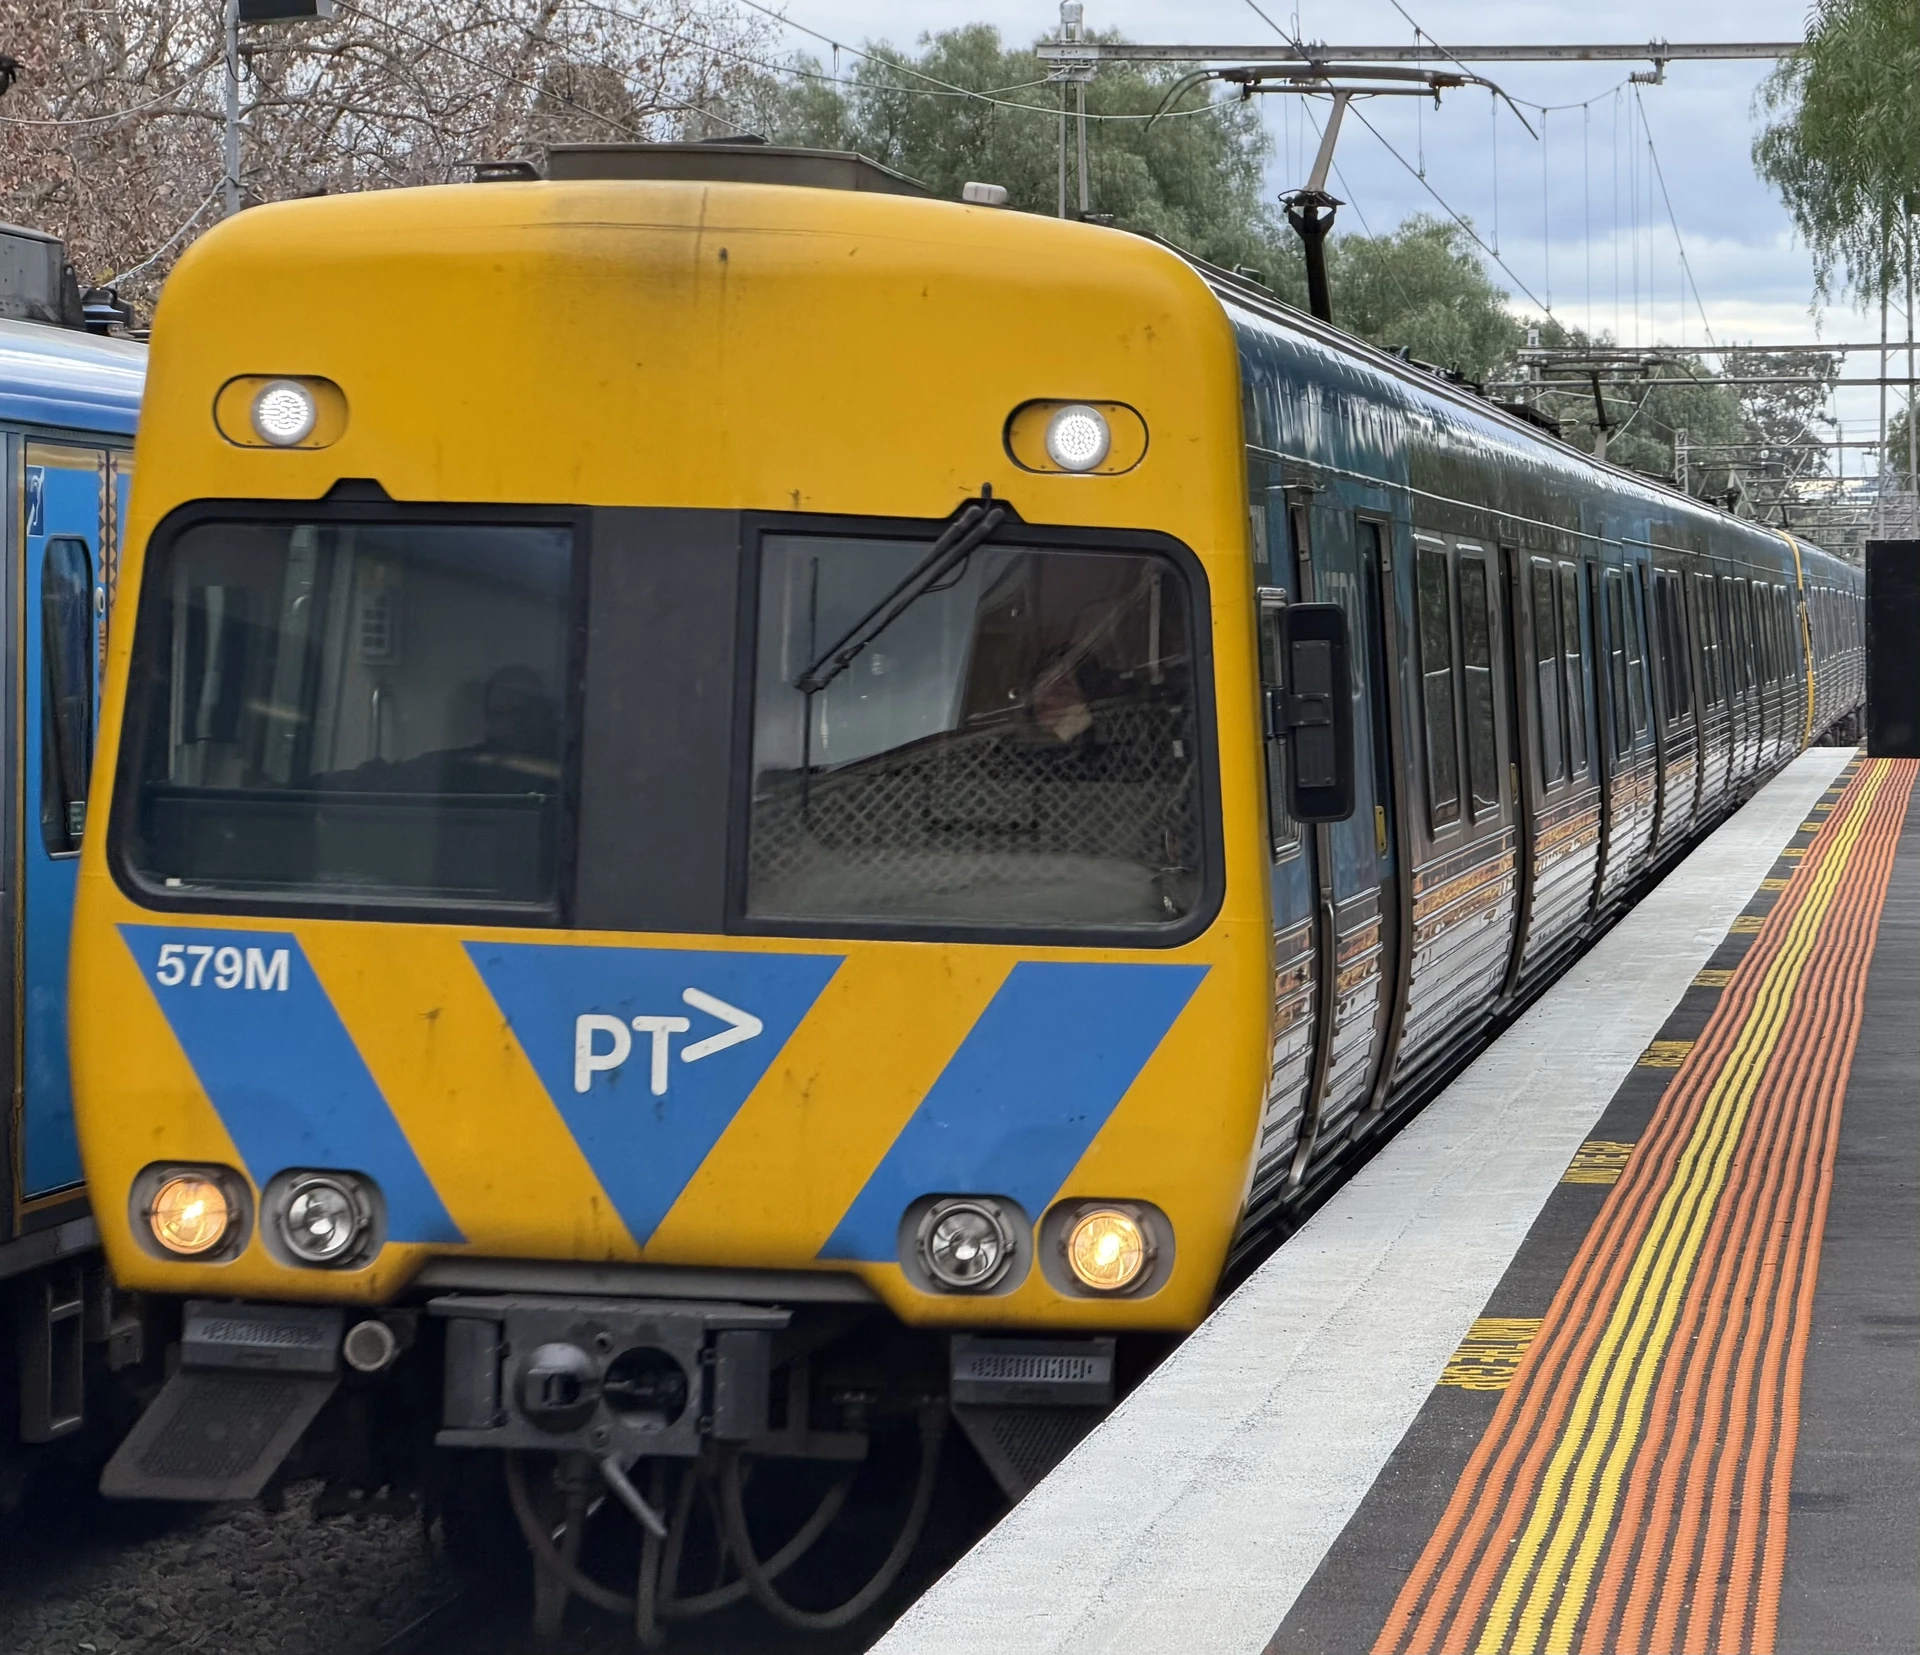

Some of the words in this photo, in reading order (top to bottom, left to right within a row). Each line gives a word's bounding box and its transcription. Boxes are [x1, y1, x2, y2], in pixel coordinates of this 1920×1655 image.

[156, 943, 290, 992] 579M
[1464, 1317, 1545, 1341] MIND
[1448, 1343, 1531, 1363] THE
[1436, 1365, 1519, 1391] GAP
